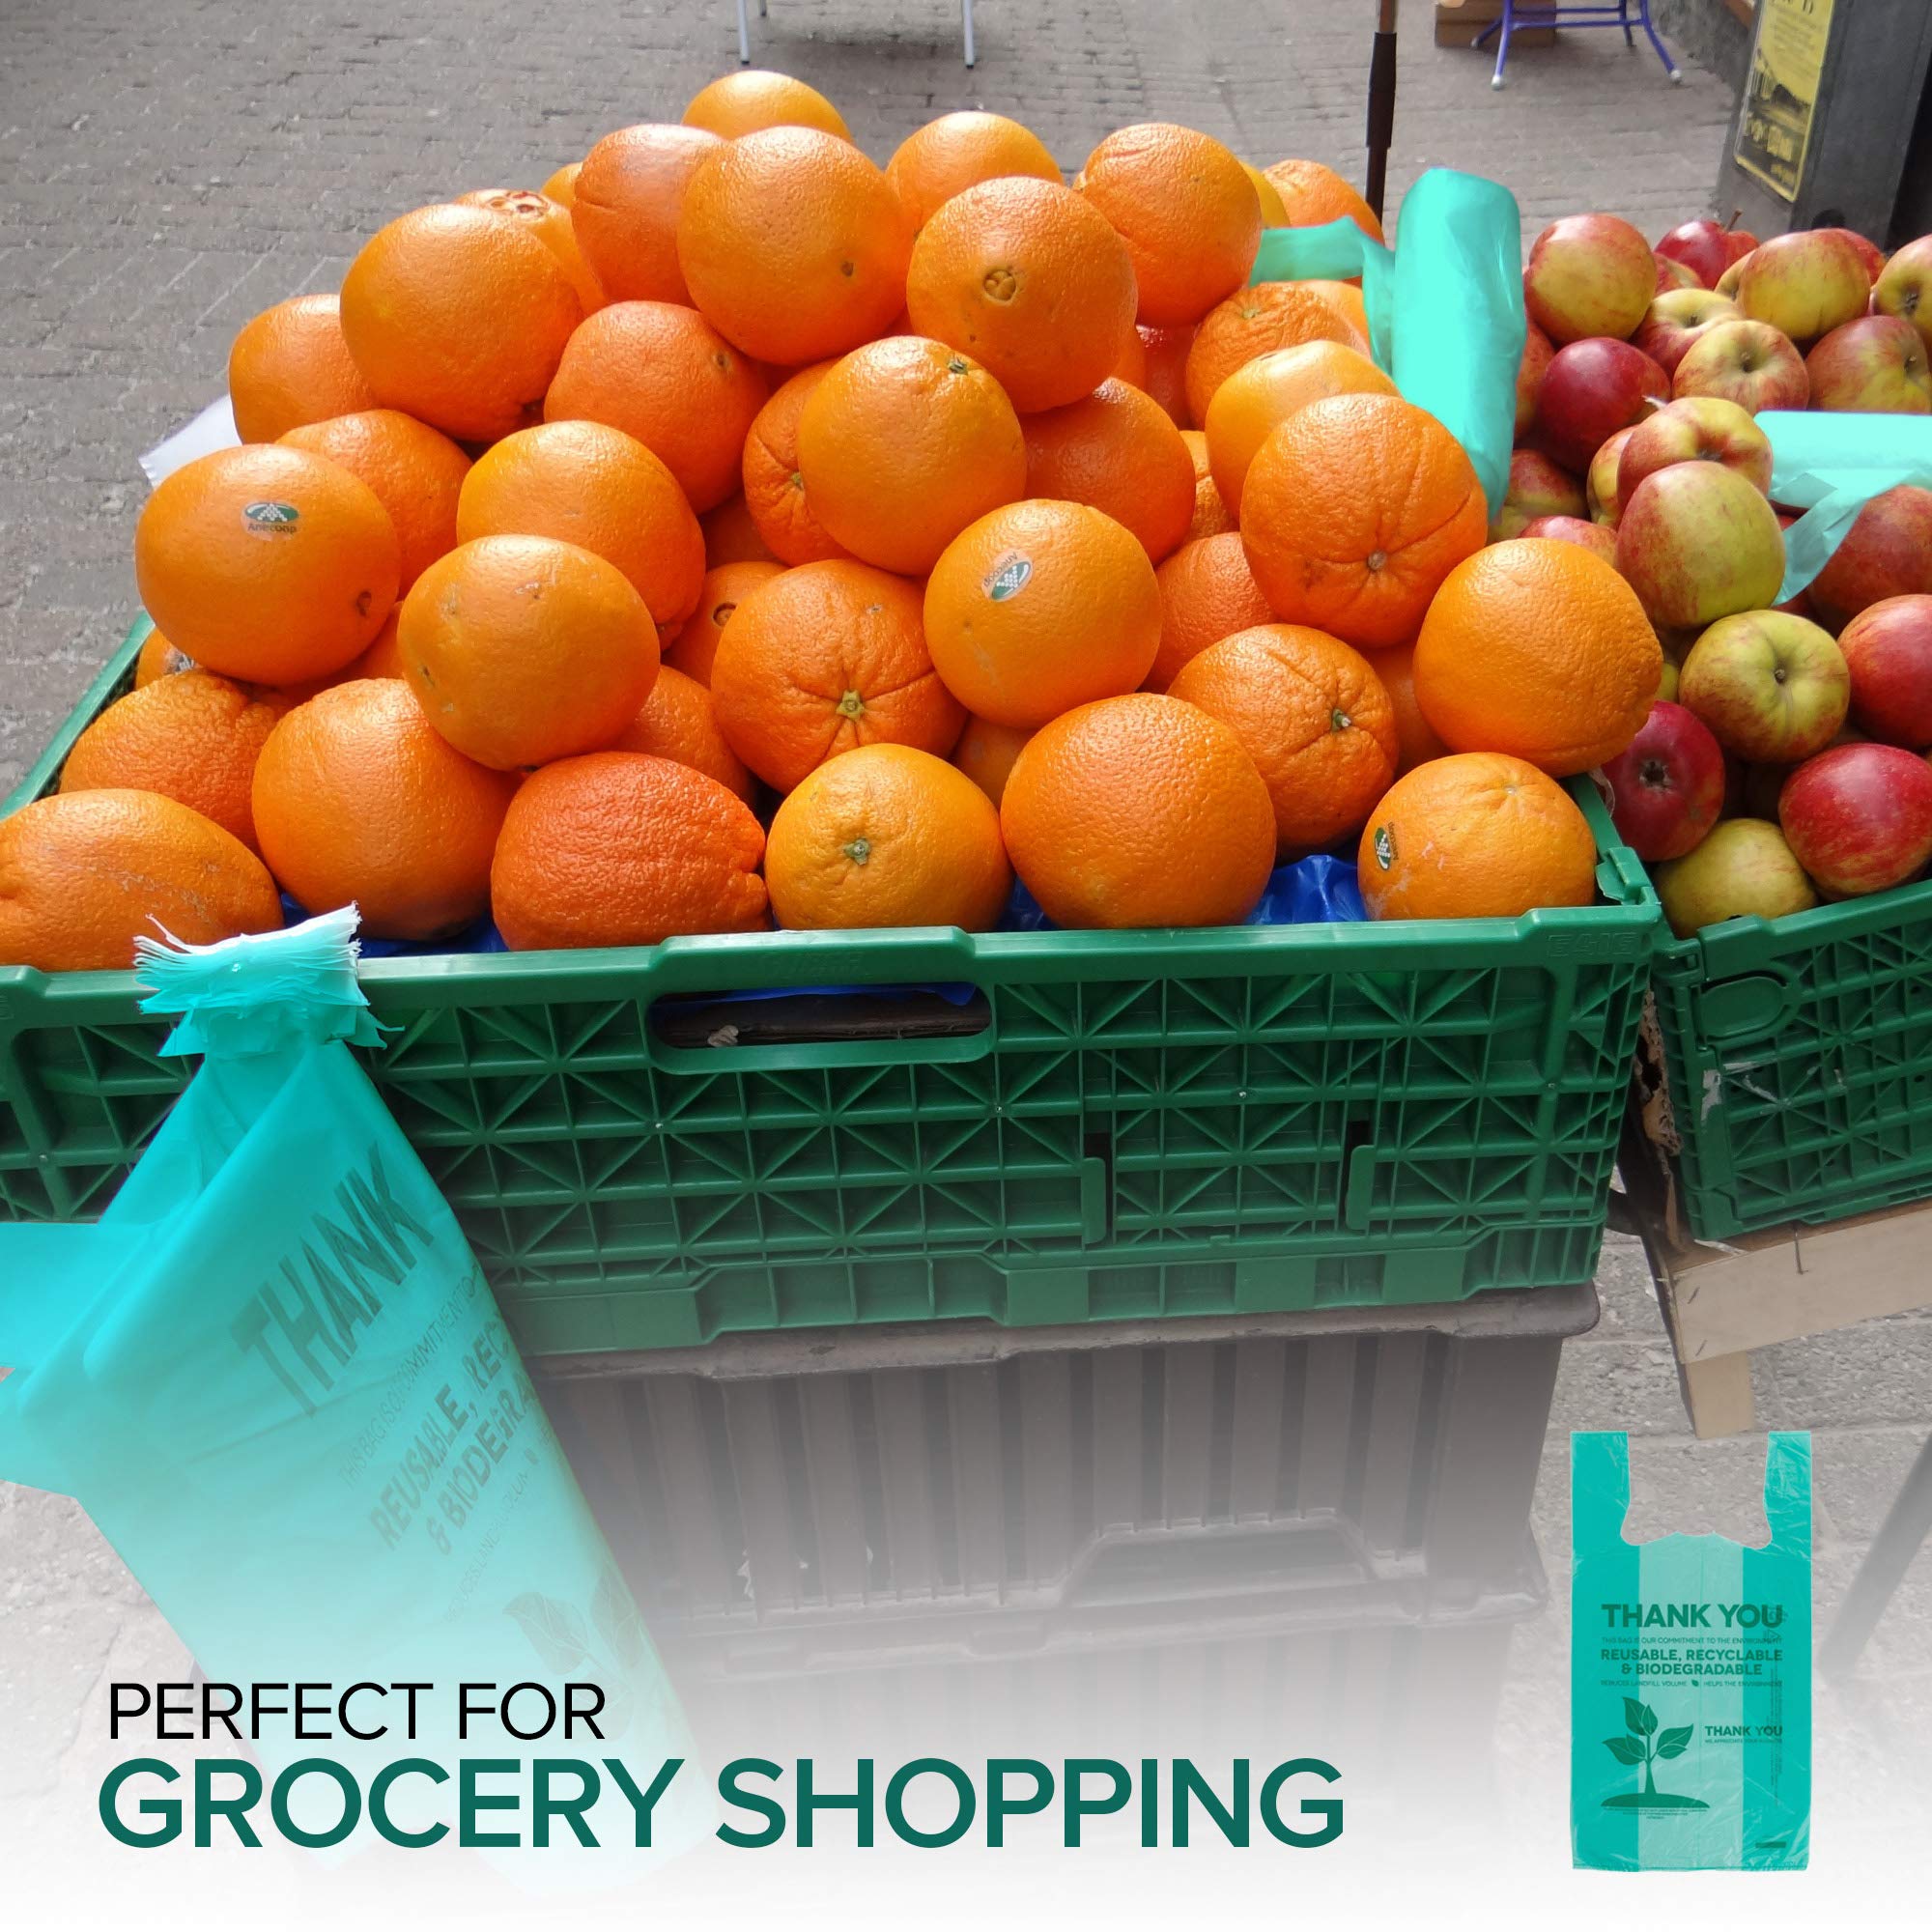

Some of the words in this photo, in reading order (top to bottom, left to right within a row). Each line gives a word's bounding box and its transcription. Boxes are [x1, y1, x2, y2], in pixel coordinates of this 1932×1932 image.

[228, 1141, 434, 1418] THANK
[1601, 1604, 1711, 1628] THANK
[1717, 1604, 1783, 1629] YOU
[1601, 1649, 1682, 1662] REUSABLE,
[1686, 1649, 1783, 1661] RECYCLABLE
[1621, 1663, 1633, 1675] &
[1635, 1663, 1763, 1675] BIODEGRADABLE
[1705, 1725, 1750, 1737] THANK
[1755, 1725, 1782, 1737] YOU
